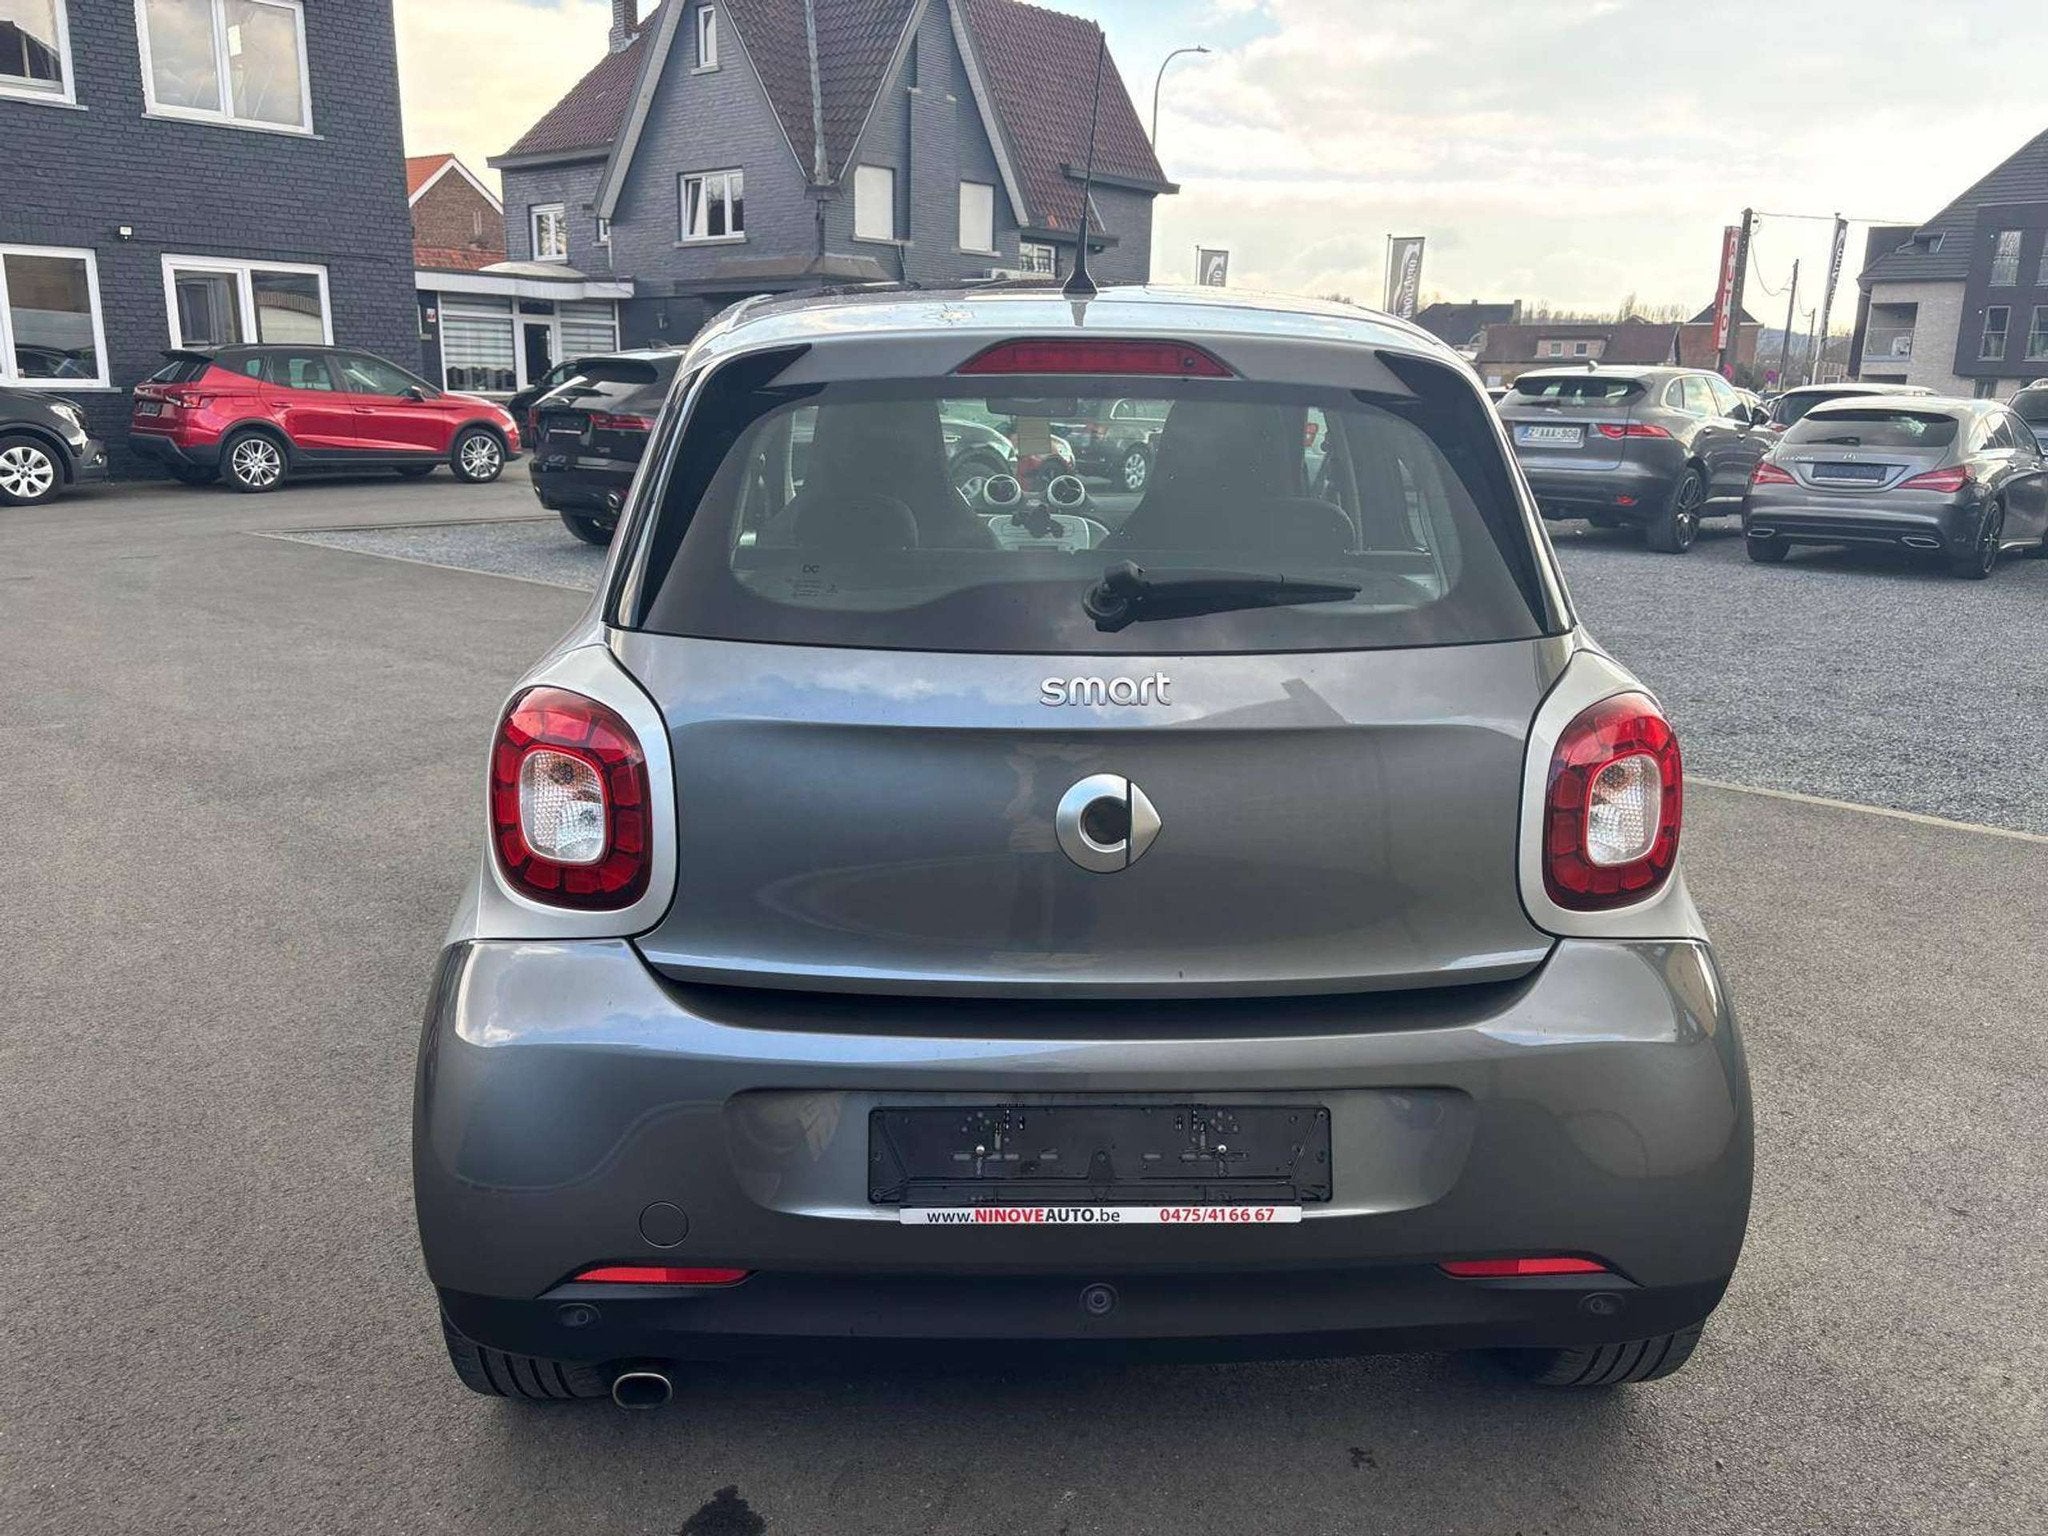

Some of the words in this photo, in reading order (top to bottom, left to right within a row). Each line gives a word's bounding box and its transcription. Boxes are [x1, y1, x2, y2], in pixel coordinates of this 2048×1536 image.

[1040, 671, 1171, 706] smart
[927, 1208, 1120, 1223] www.NINOVEAUTO.be
[1254, 1208, 1274, 1222] 67
